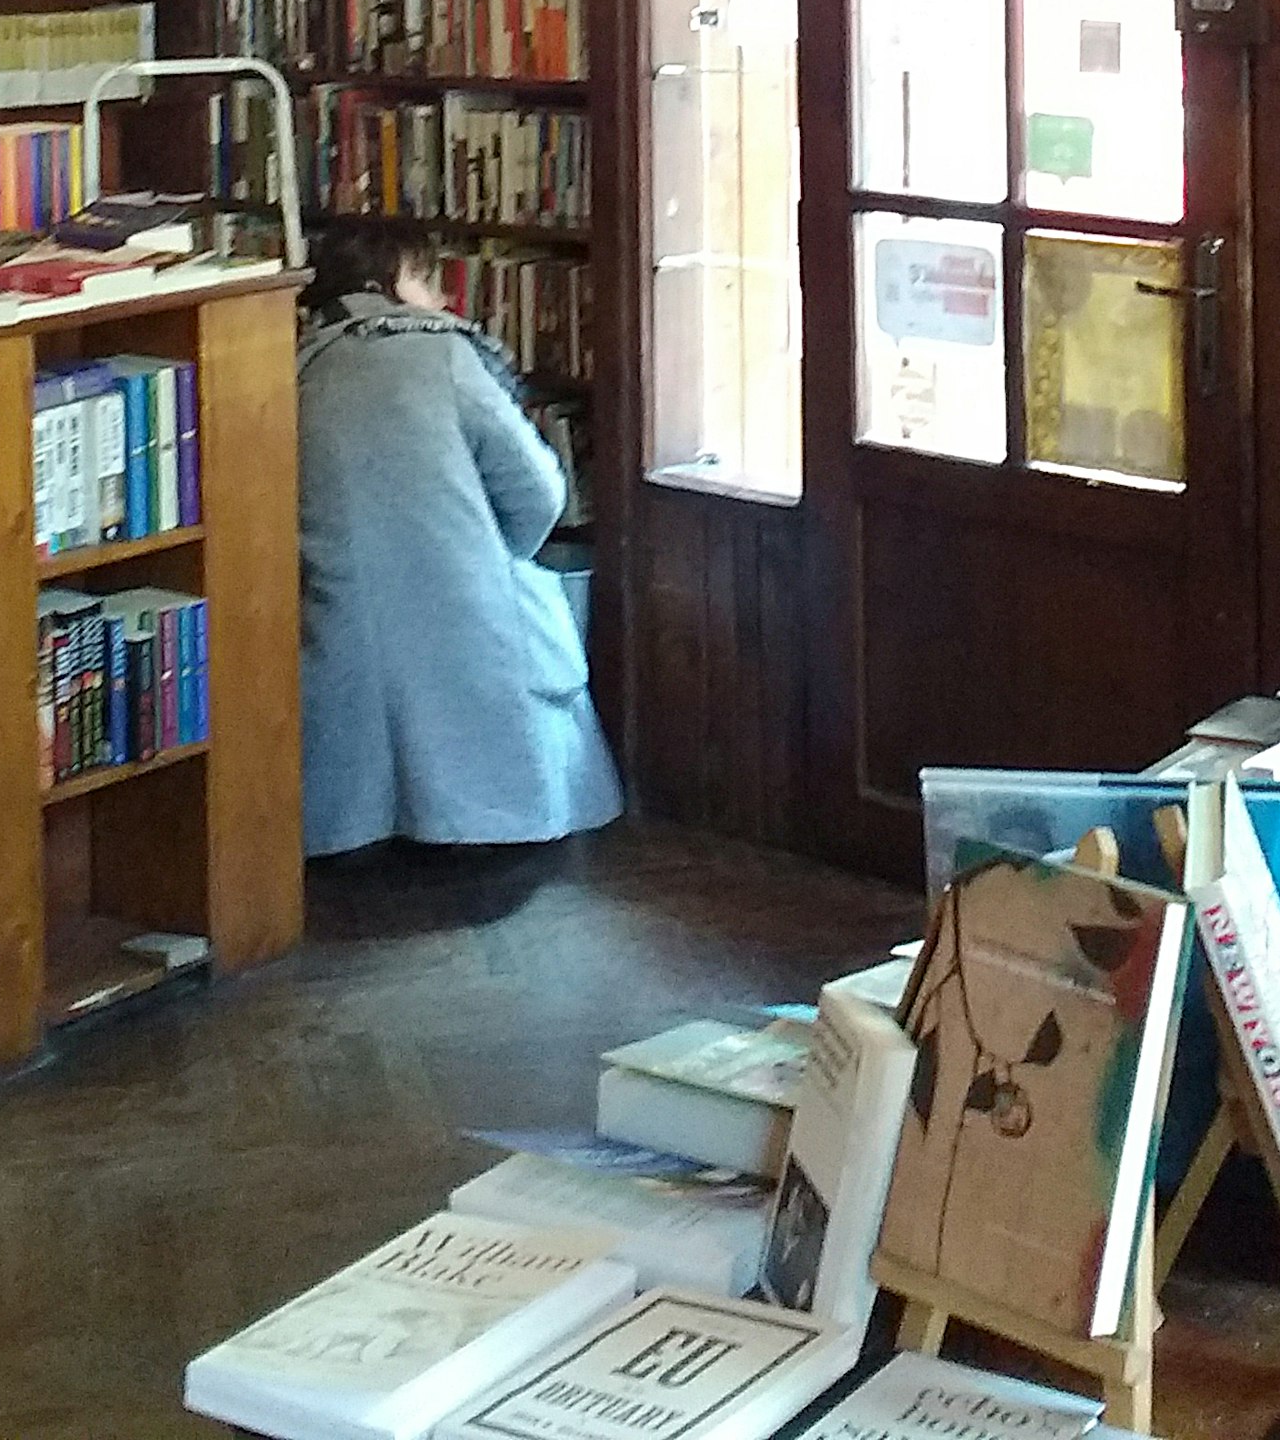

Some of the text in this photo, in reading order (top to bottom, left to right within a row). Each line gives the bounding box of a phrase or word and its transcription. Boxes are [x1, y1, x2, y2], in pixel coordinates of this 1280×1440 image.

[376, 1250, 504, 1288] Blake
[414, 1229, 584, 1272] William
[611, 1326, 742, 1388] EU
[534, 1380, 687, 1431] OBITUARY
